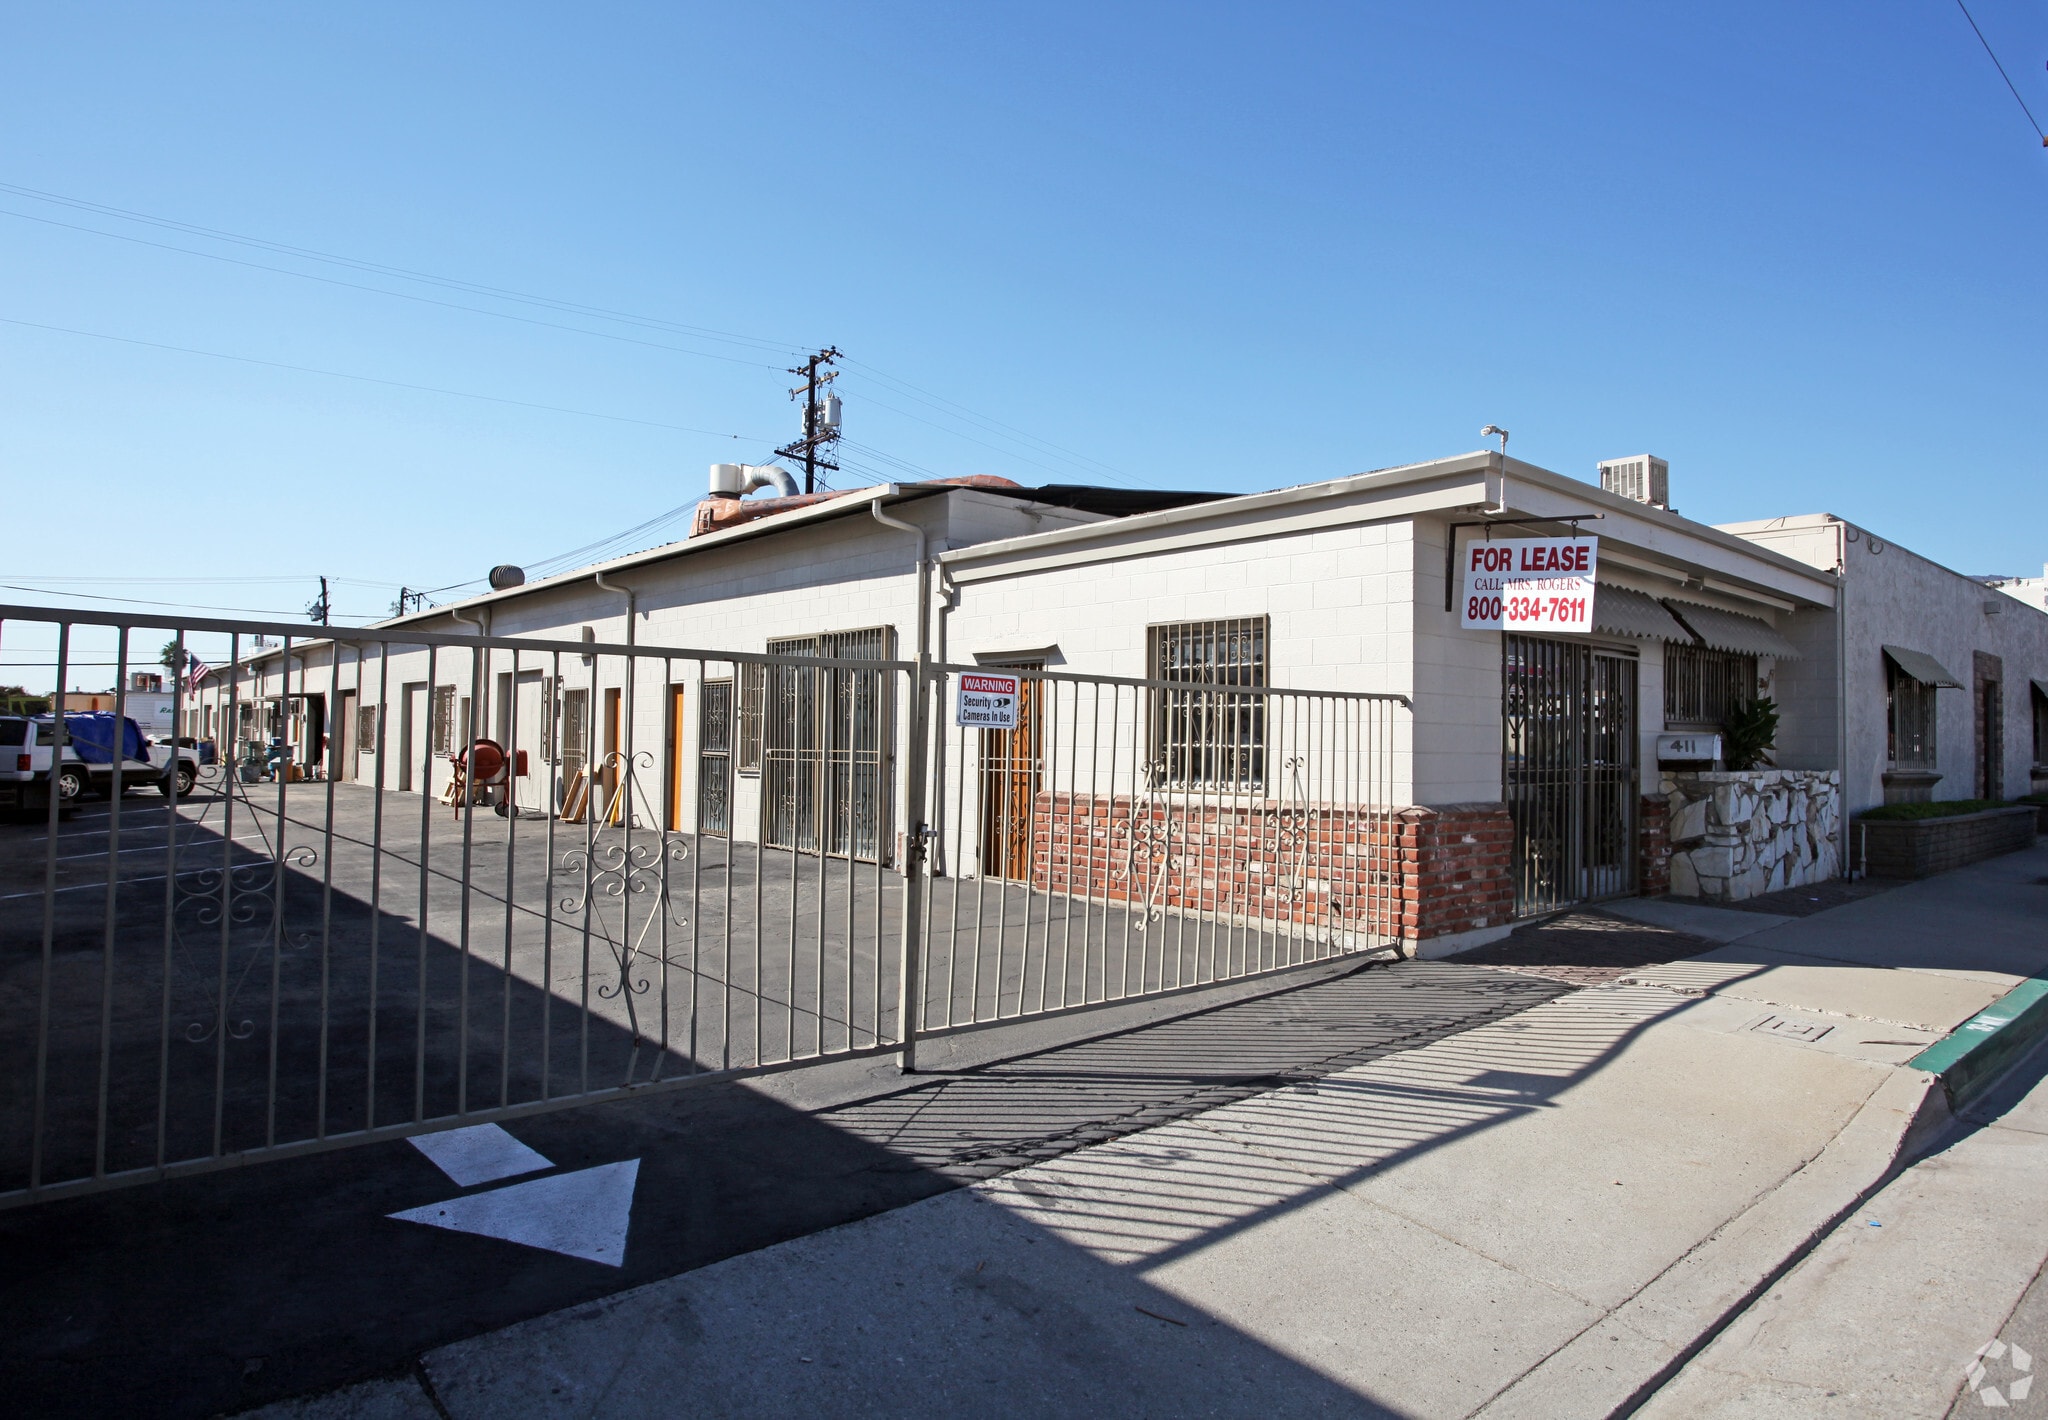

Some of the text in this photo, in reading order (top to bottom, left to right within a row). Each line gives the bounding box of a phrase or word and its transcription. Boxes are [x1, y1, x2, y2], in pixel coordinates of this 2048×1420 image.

[1471, 546, 1590, 572] FOR LEASE
[1474, 577, 1581, 591] CALL: MRS. ROGERS
[1468, 596, 1586, 622] 800-334-7611
[964, 678, 1013, 693] WARNING
[963, 694, 992, 710] Security
[963, 709, 1011, 723] Cameras In Use
[1670, 739, 1696, 754] 411
